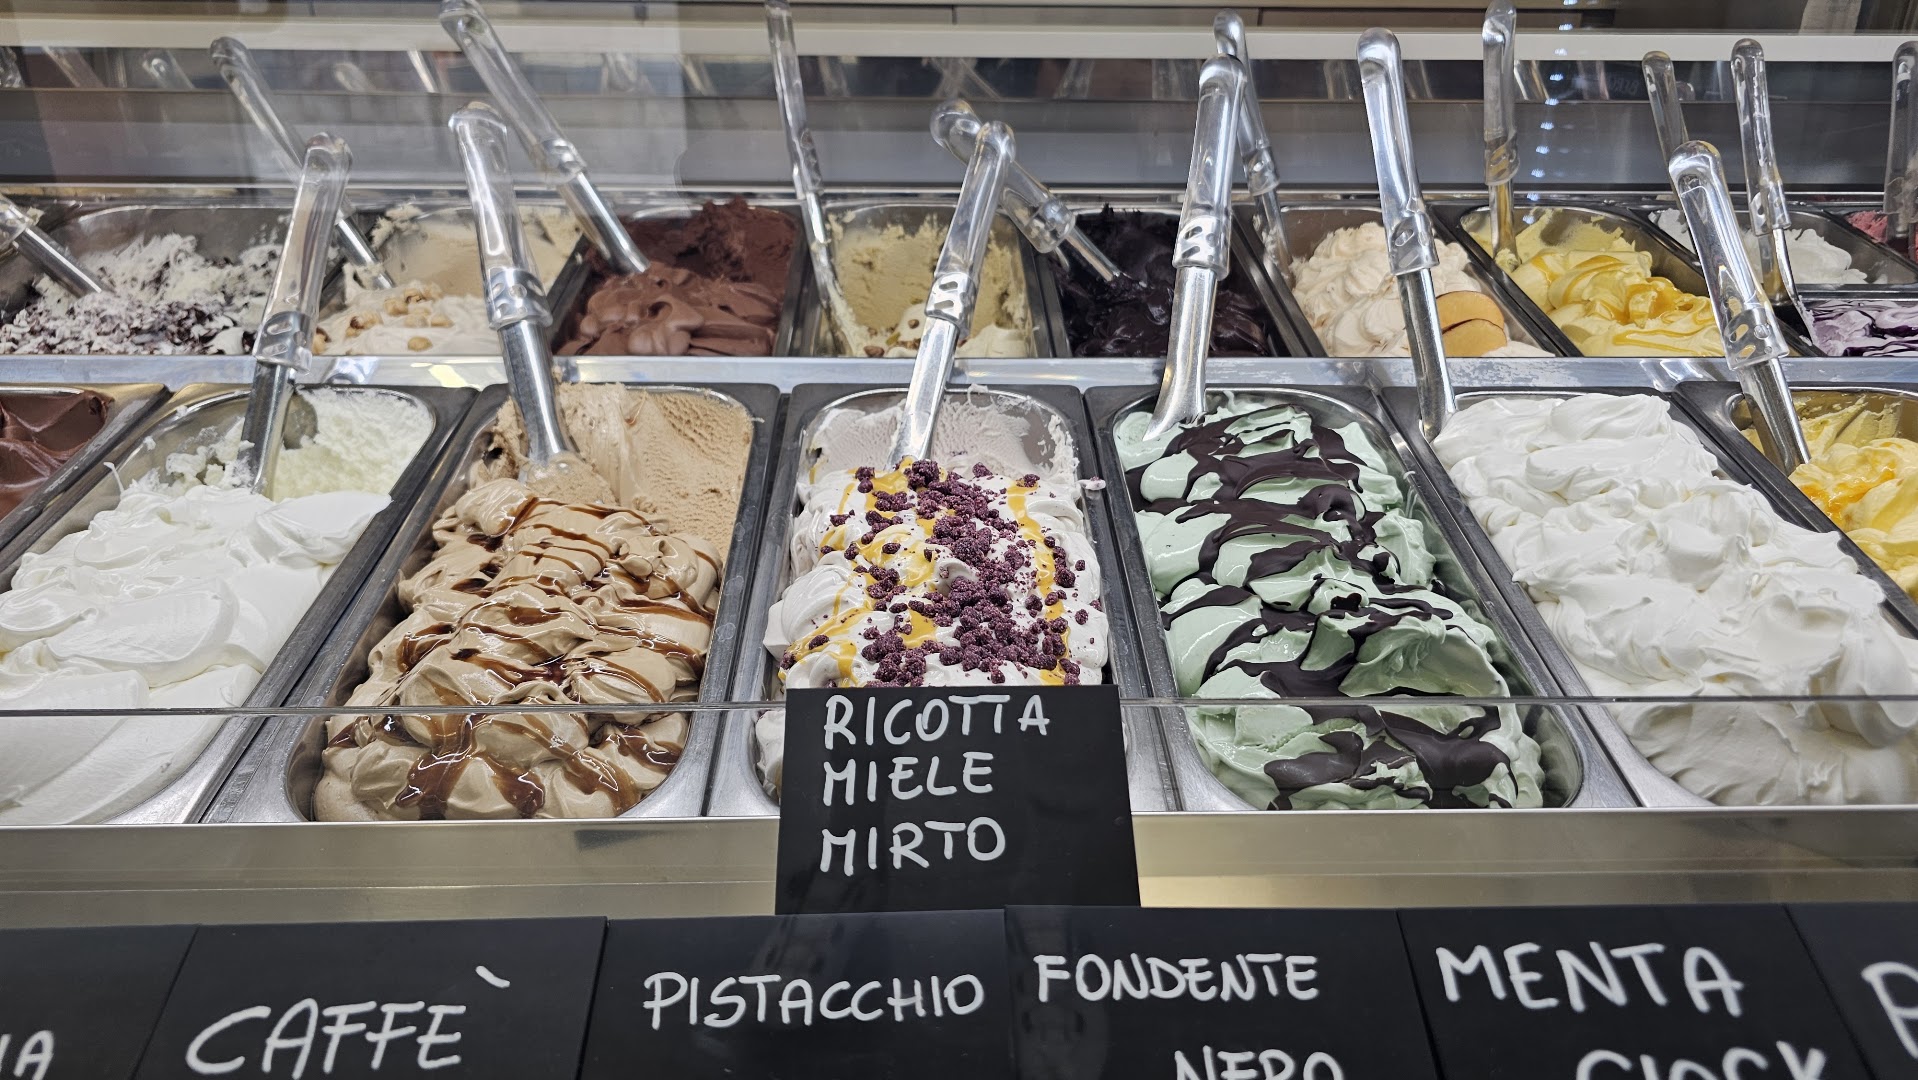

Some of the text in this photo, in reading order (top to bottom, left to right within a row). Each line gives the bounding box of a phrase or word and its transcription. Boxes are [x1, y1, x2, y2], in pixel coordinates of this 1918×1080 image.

[823, 694, 1050, 750] RICOTTA
[822, 752, 994, 807] MIELE
[819, 816, 1006, 877] MIRTO
[642, 971, 985, 1030] PISTACCHIO
[1033, 952, 1320, 1004] FONDENTE
[1434, 941, 1744, 1017] MENTA
[185, 965, 511, 1080] CAFFÈ
